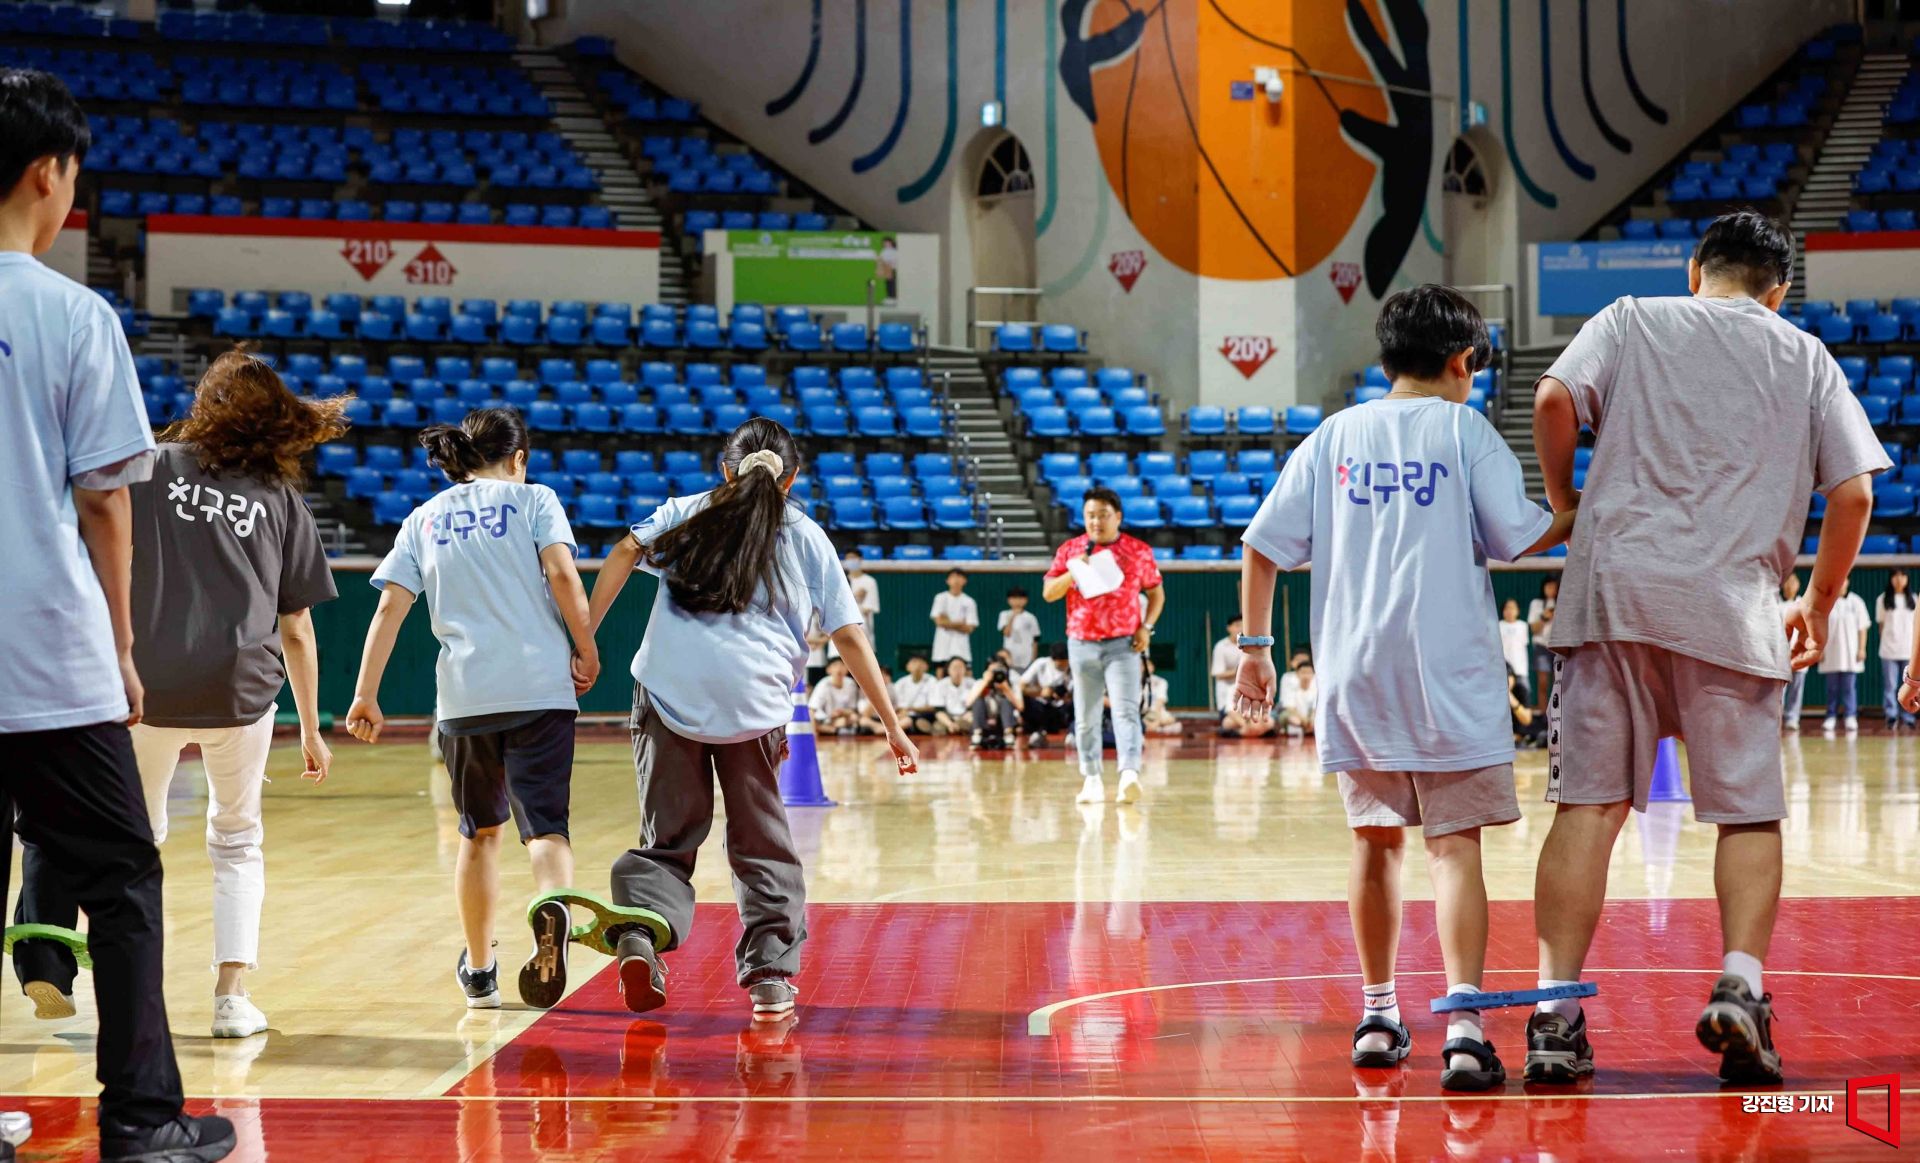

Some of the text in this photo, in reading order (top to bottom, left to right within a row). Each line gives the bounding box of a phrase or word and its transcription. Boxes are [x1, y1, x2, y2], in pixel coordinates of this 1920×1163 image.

[349, 240, 388, 264] 210
[1115, 251, 1142, 276] 209
[411, 260, 450, 284] 310
[1227, 336, 1269, 362] 209
[1337, 456, 1449, 507] 친구랑
[168, 476, 267, 538] 친구랑
[424, 503, 517, 545] 친구랑
